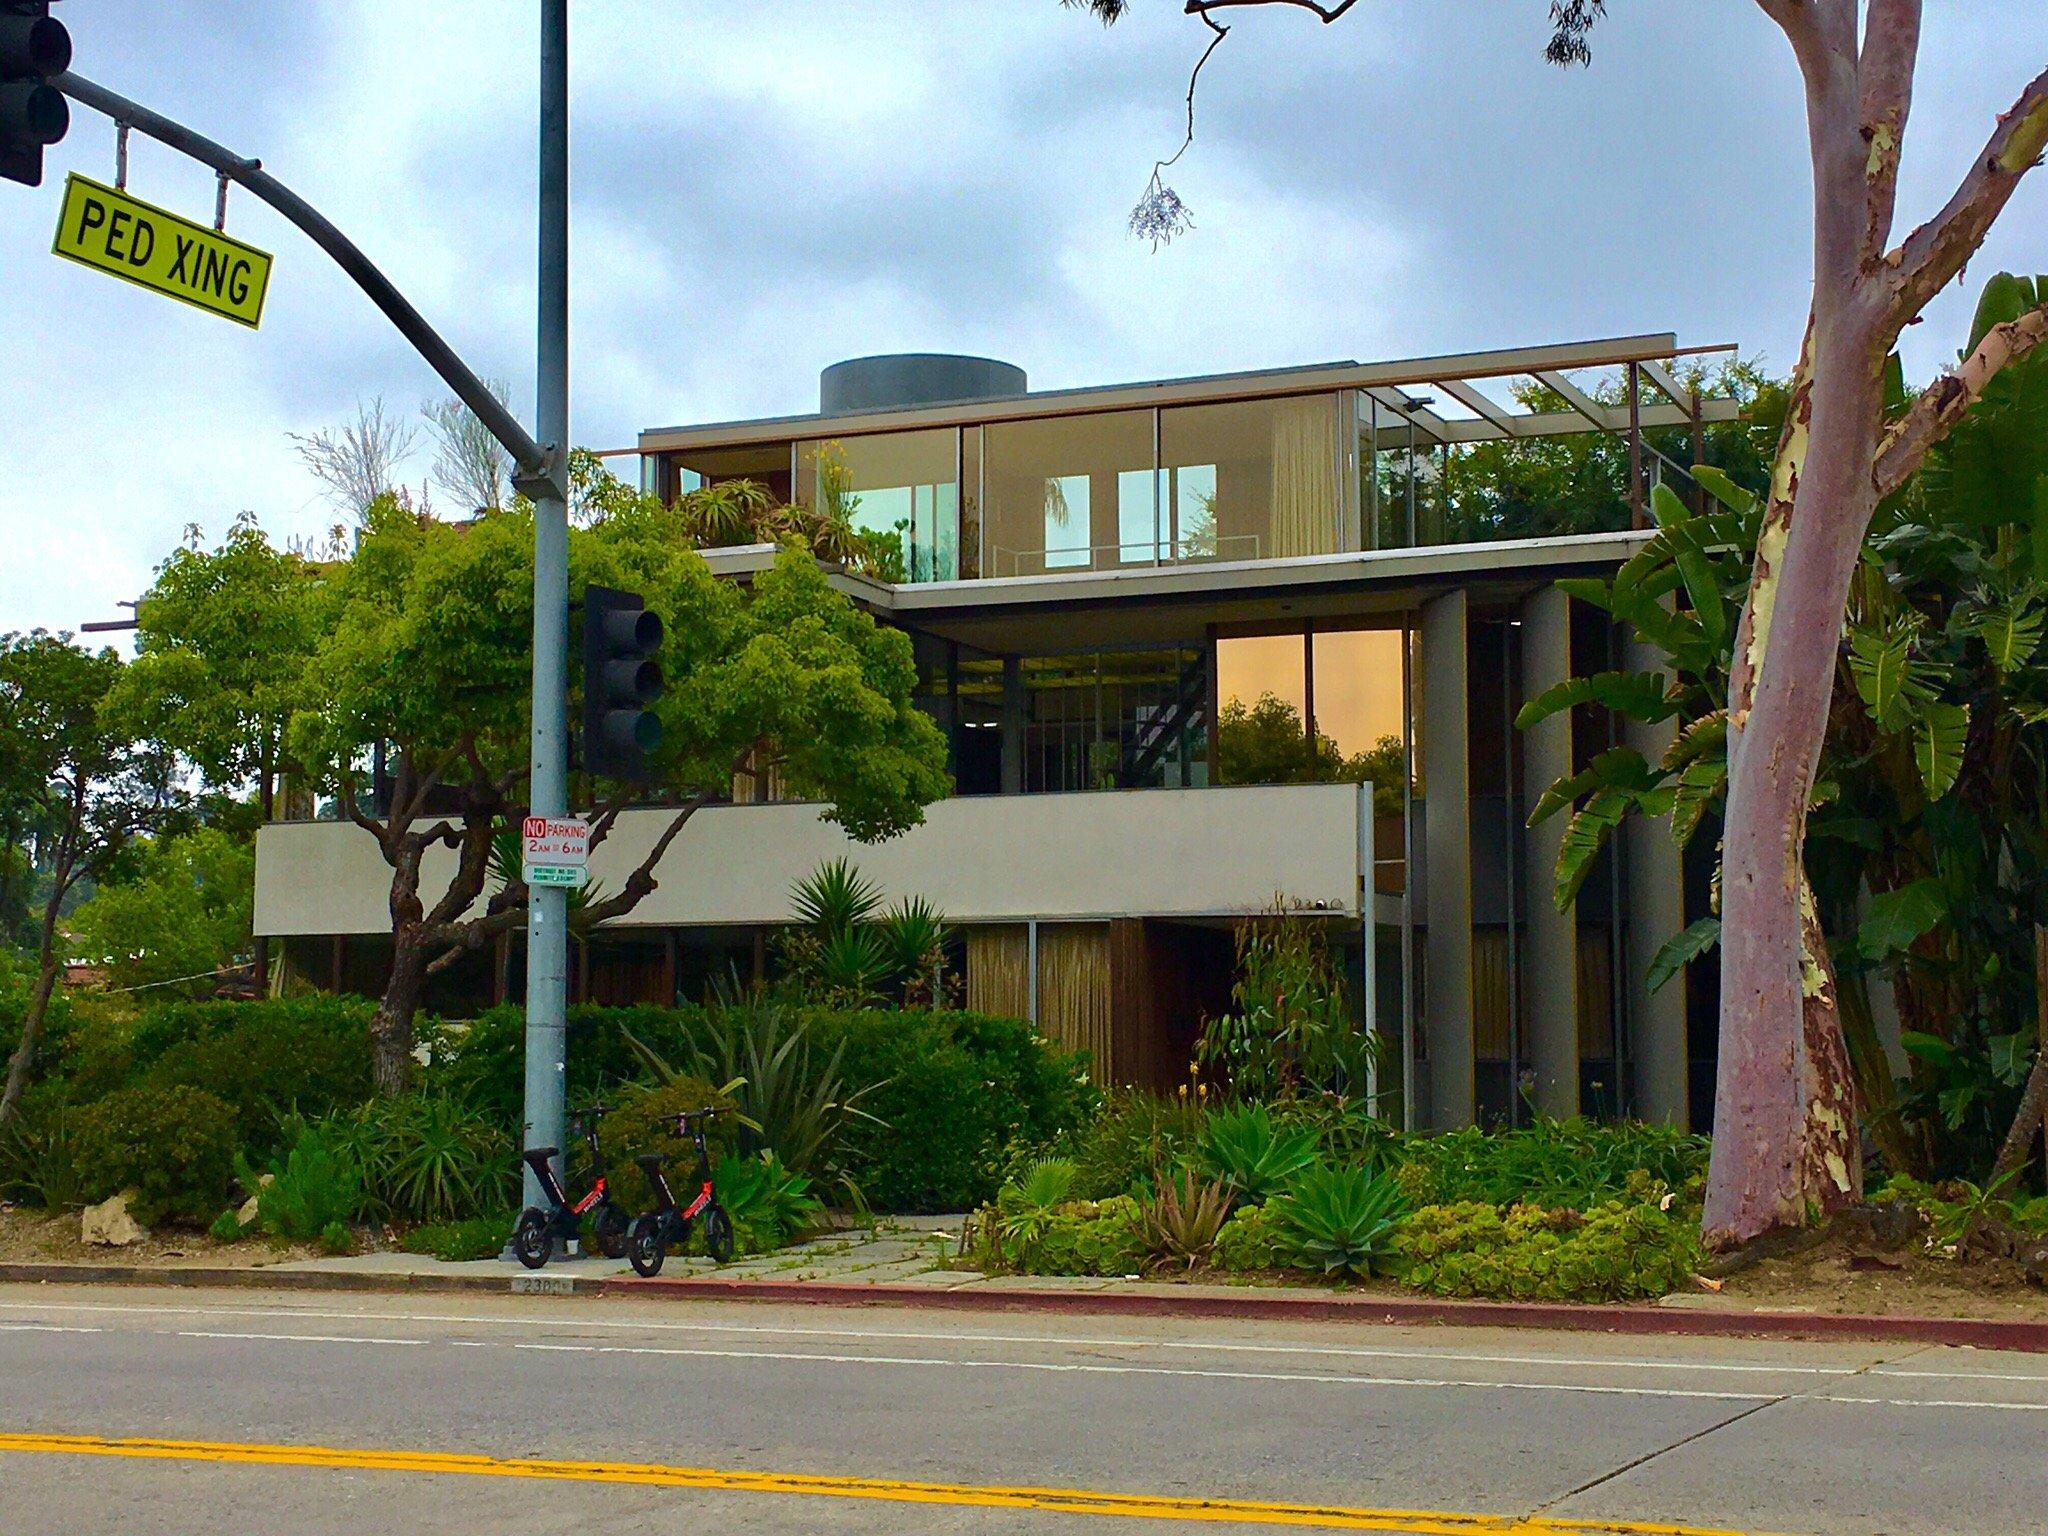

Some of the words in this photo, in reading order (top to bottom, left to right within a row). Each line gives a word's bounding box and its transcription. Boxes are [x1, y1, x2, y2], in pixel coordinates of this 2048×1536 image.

[77, 197, 155, 267] PED
[167, 234, 252, 306] XING
[526, 820, 545, 837] NO
[547, 824, 585, 838] PARKING
